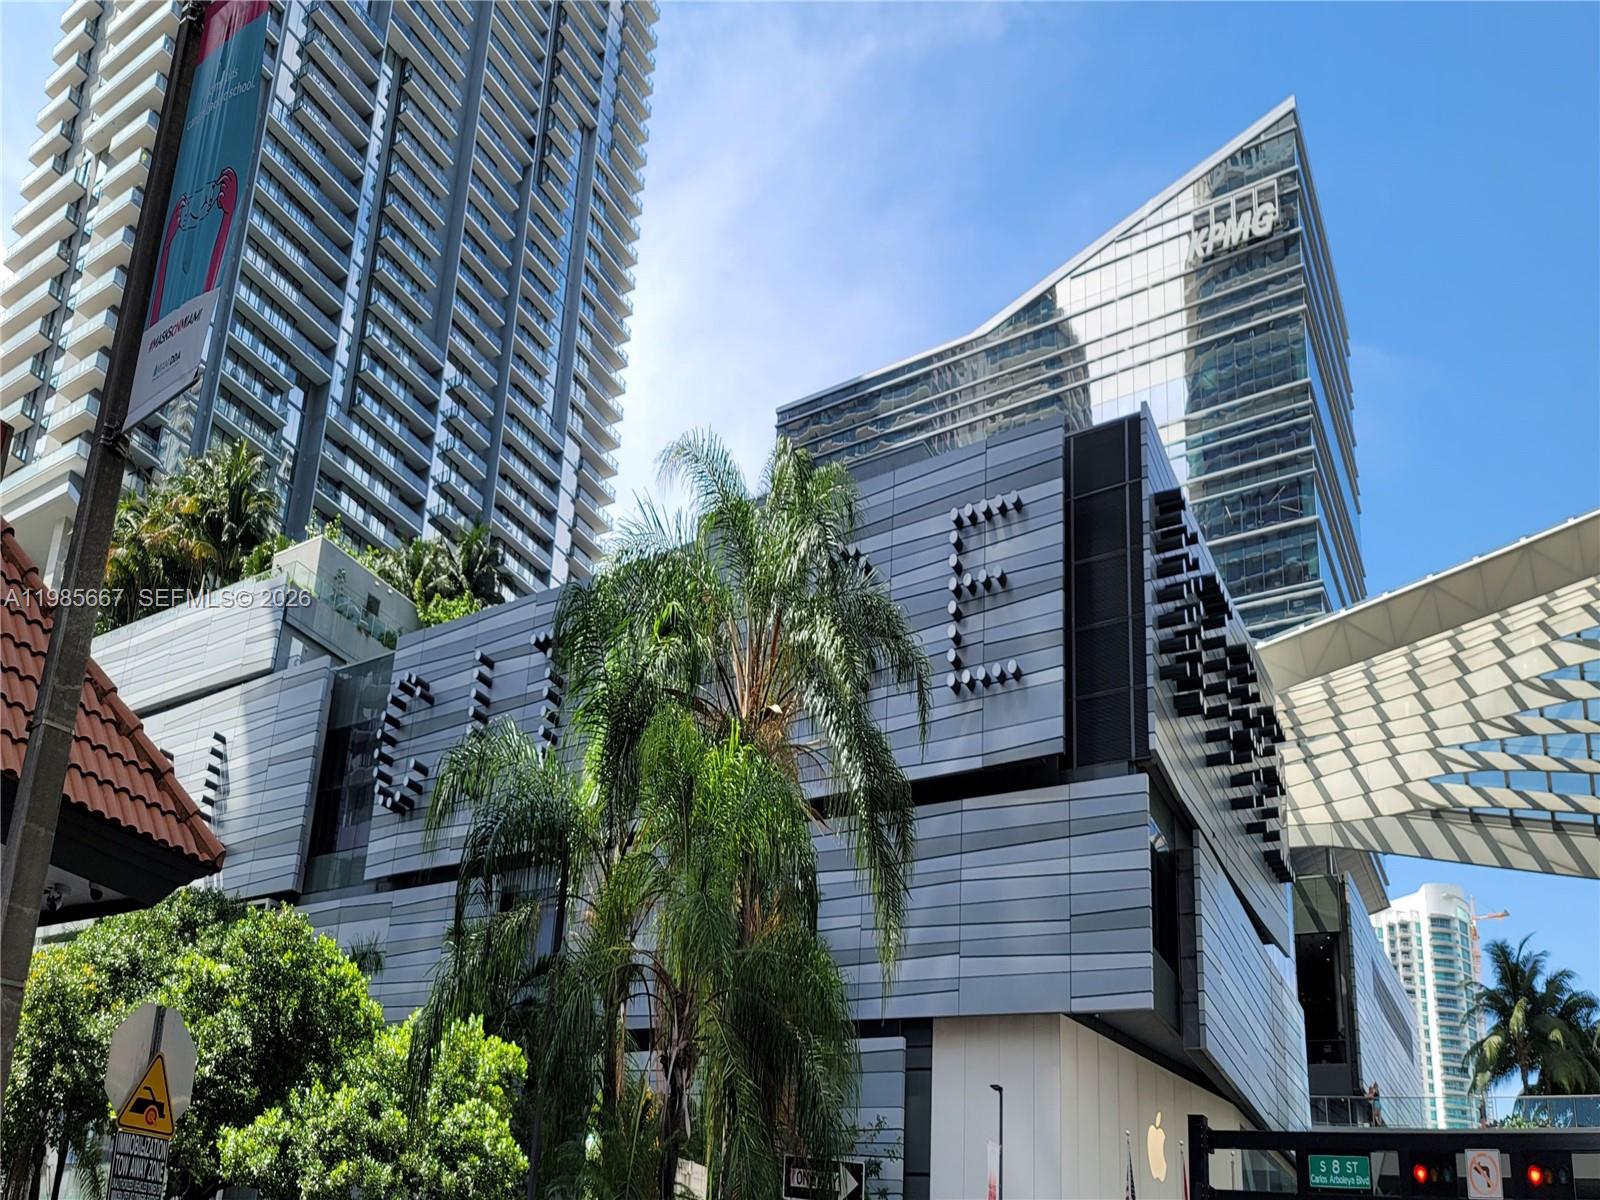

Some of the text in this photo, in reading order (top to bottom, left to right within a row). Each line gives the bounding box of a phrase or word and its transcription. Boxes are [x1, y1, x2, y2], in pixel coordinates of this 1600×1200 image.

[1187, 201, 1277, 261] KPMG
[116, 1132, 169, 1161] IMMOBILIZATION
[114, 1155, 165, 1183] TOW AWAY ZONE
[1311, 1173, 1370, 1186] Carlos Arboleya Blvd
[1319, 1159, 1359, 1174] S 8 ST
